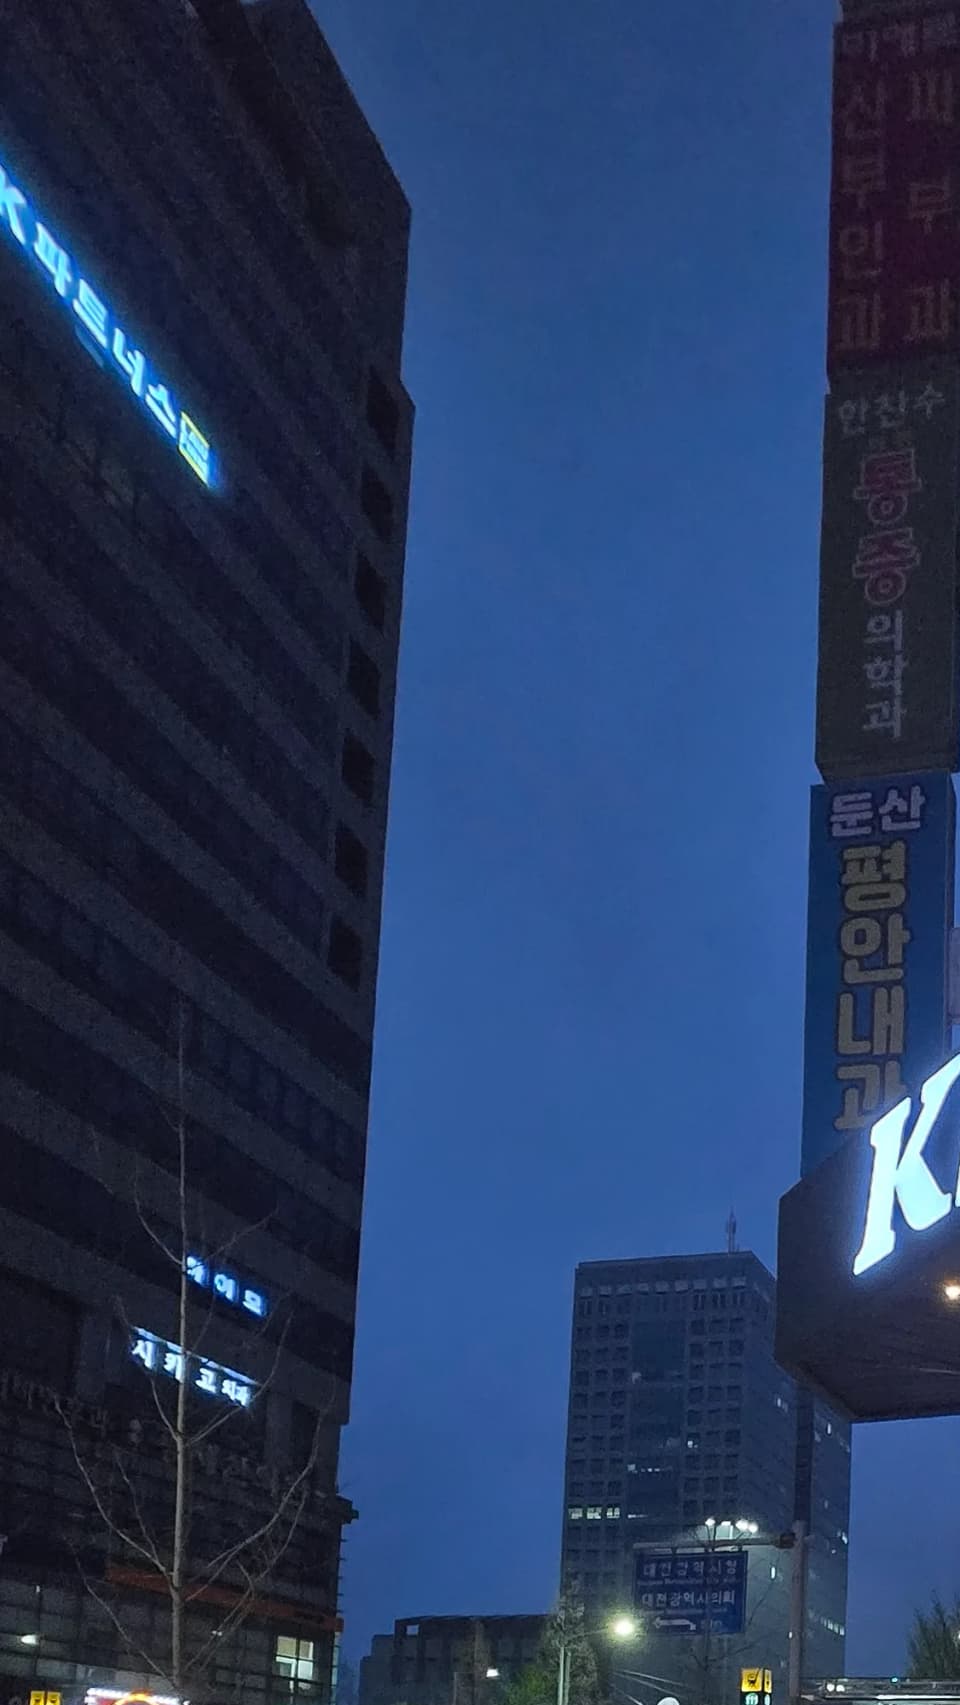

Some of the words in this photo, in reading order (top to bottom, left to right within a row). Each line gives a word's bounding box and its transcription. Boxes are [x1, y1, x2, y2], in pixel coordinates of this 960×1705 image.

[852, 446, 923, 739] 통증의학과
[829, 784, 927, 838] 둔산
[833, 840, 913, 1131] 평안내과
[641, 1589, 736, 1609] 대전광역시의회
